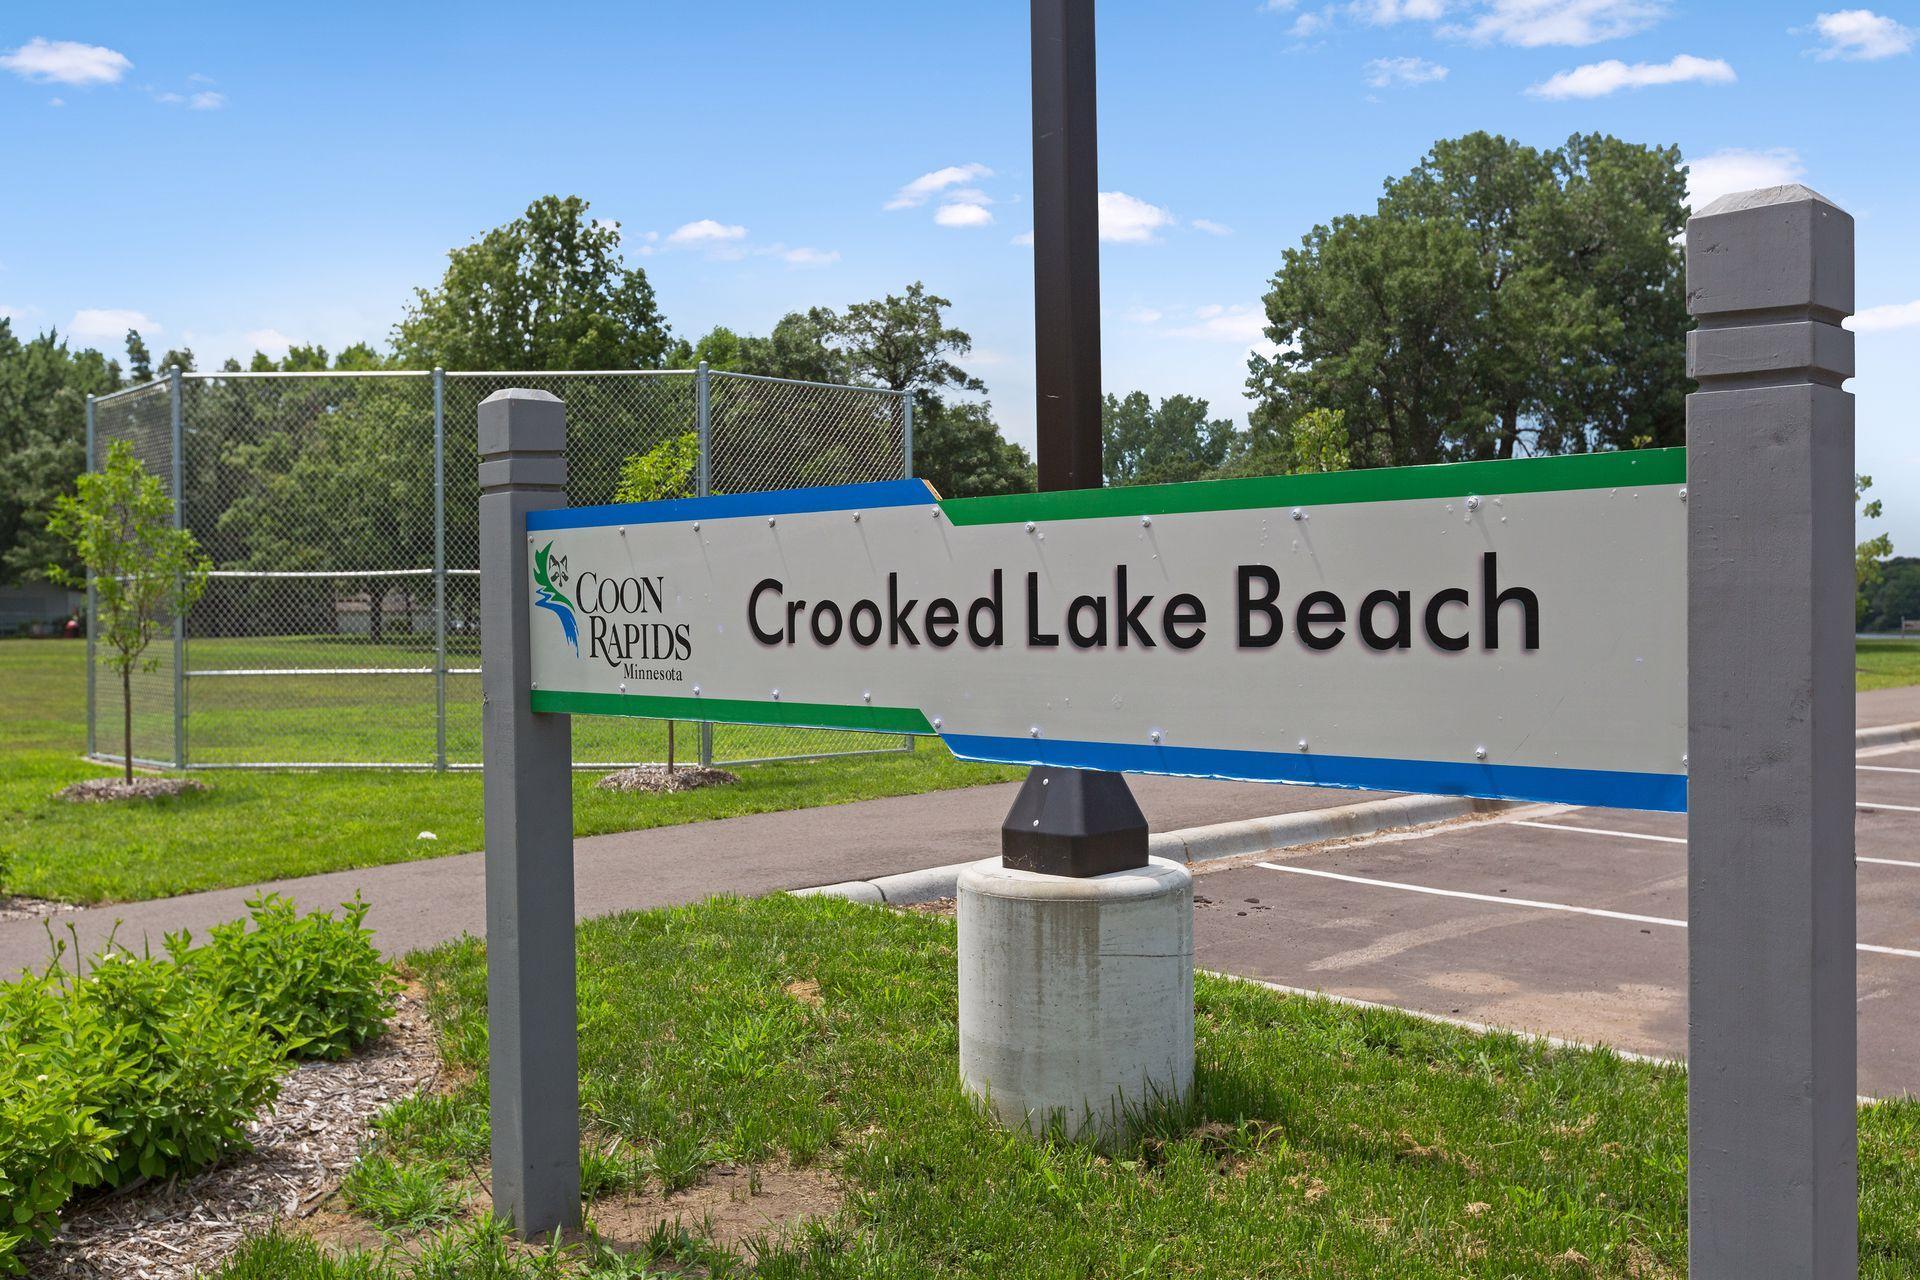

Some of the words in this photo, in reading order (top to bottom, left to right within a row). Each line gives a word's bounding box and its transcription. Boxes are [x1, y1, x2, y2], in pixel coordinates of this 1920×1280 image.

[576, 572, 664, 614] COON
[747, 569, 1004, 649] Crooked
[1027, 565, 1207, 652] Lake
[1236, 552, 1539, 654] Beach
[589, 615, 692, 667] RAPIDS
[624, 663, 683, 681] Minnesota
